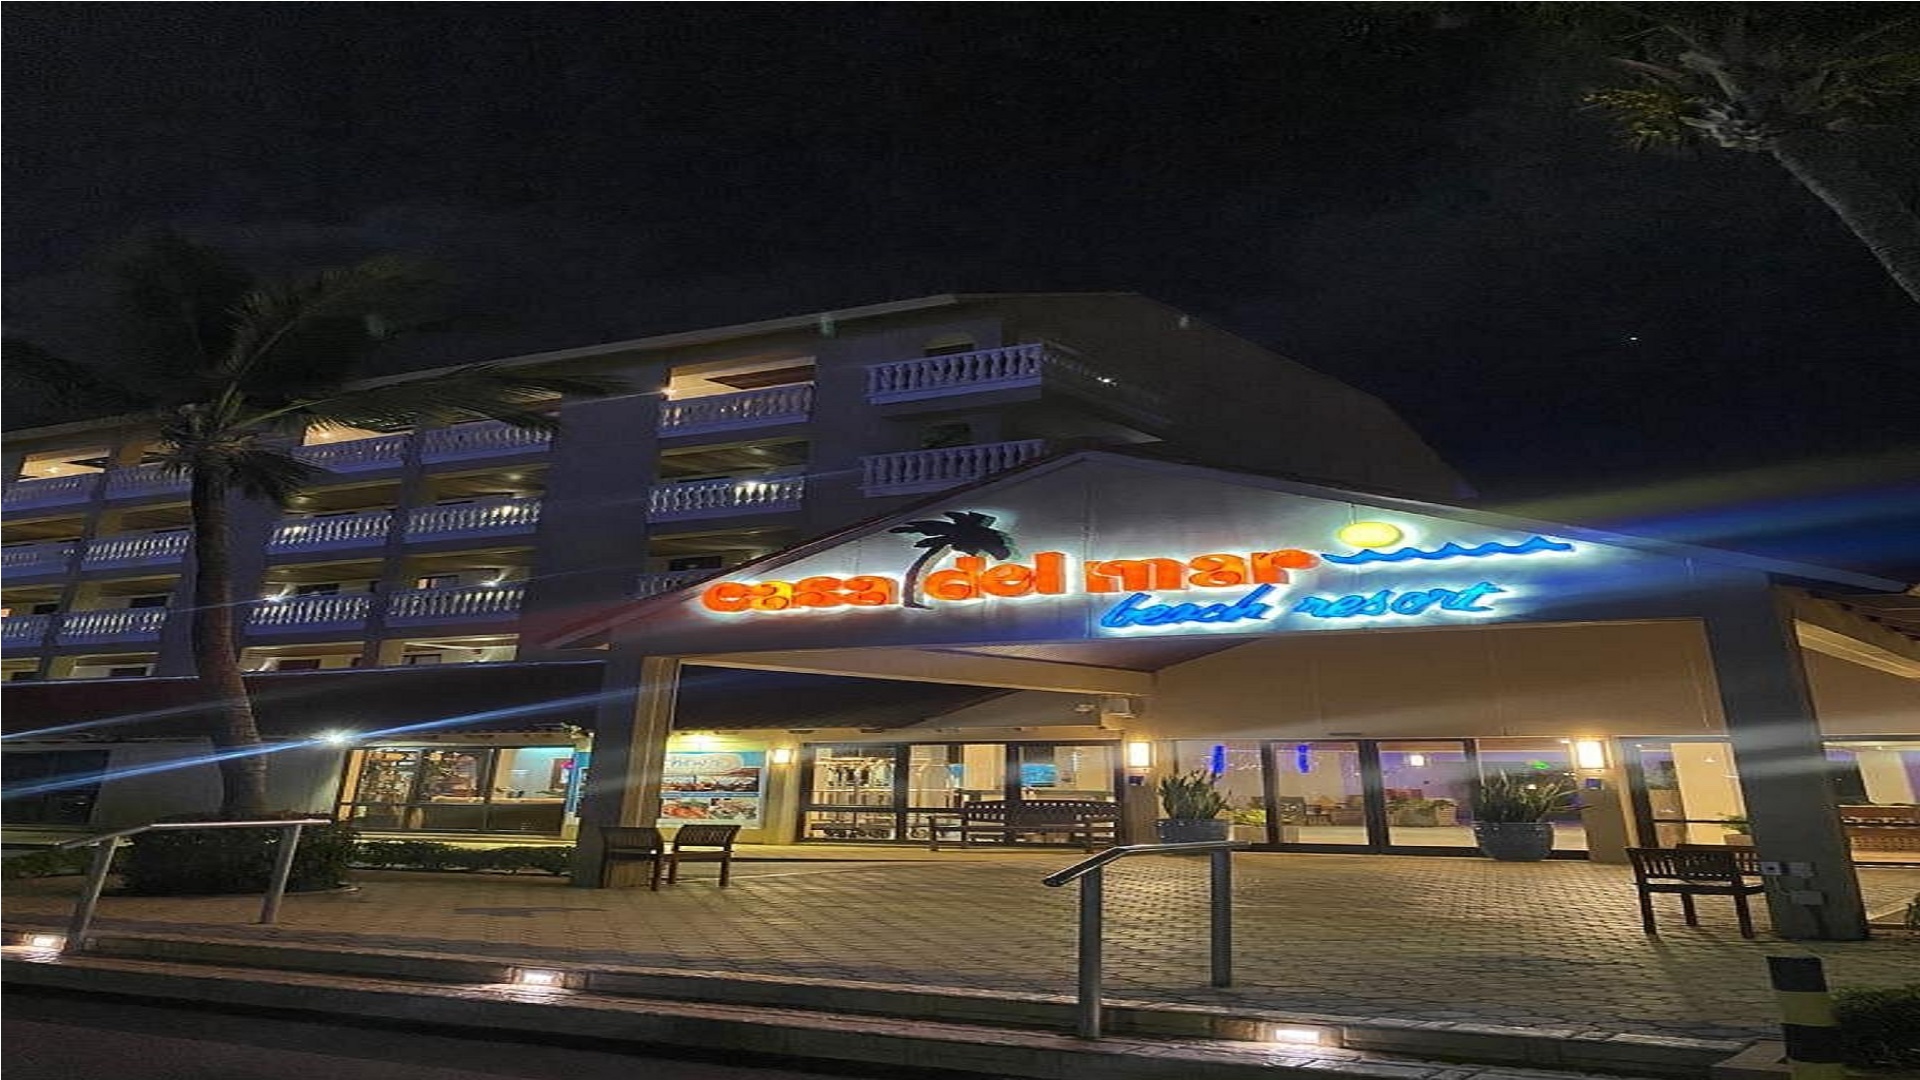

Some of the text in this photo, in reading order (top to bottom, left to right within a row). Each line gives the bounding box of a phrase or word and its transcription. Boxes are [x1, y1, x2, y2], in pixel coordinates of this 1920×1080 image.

[703, 549, 1320, 613] casa del mar
[1100, 582, 1507, 627] beach resort
